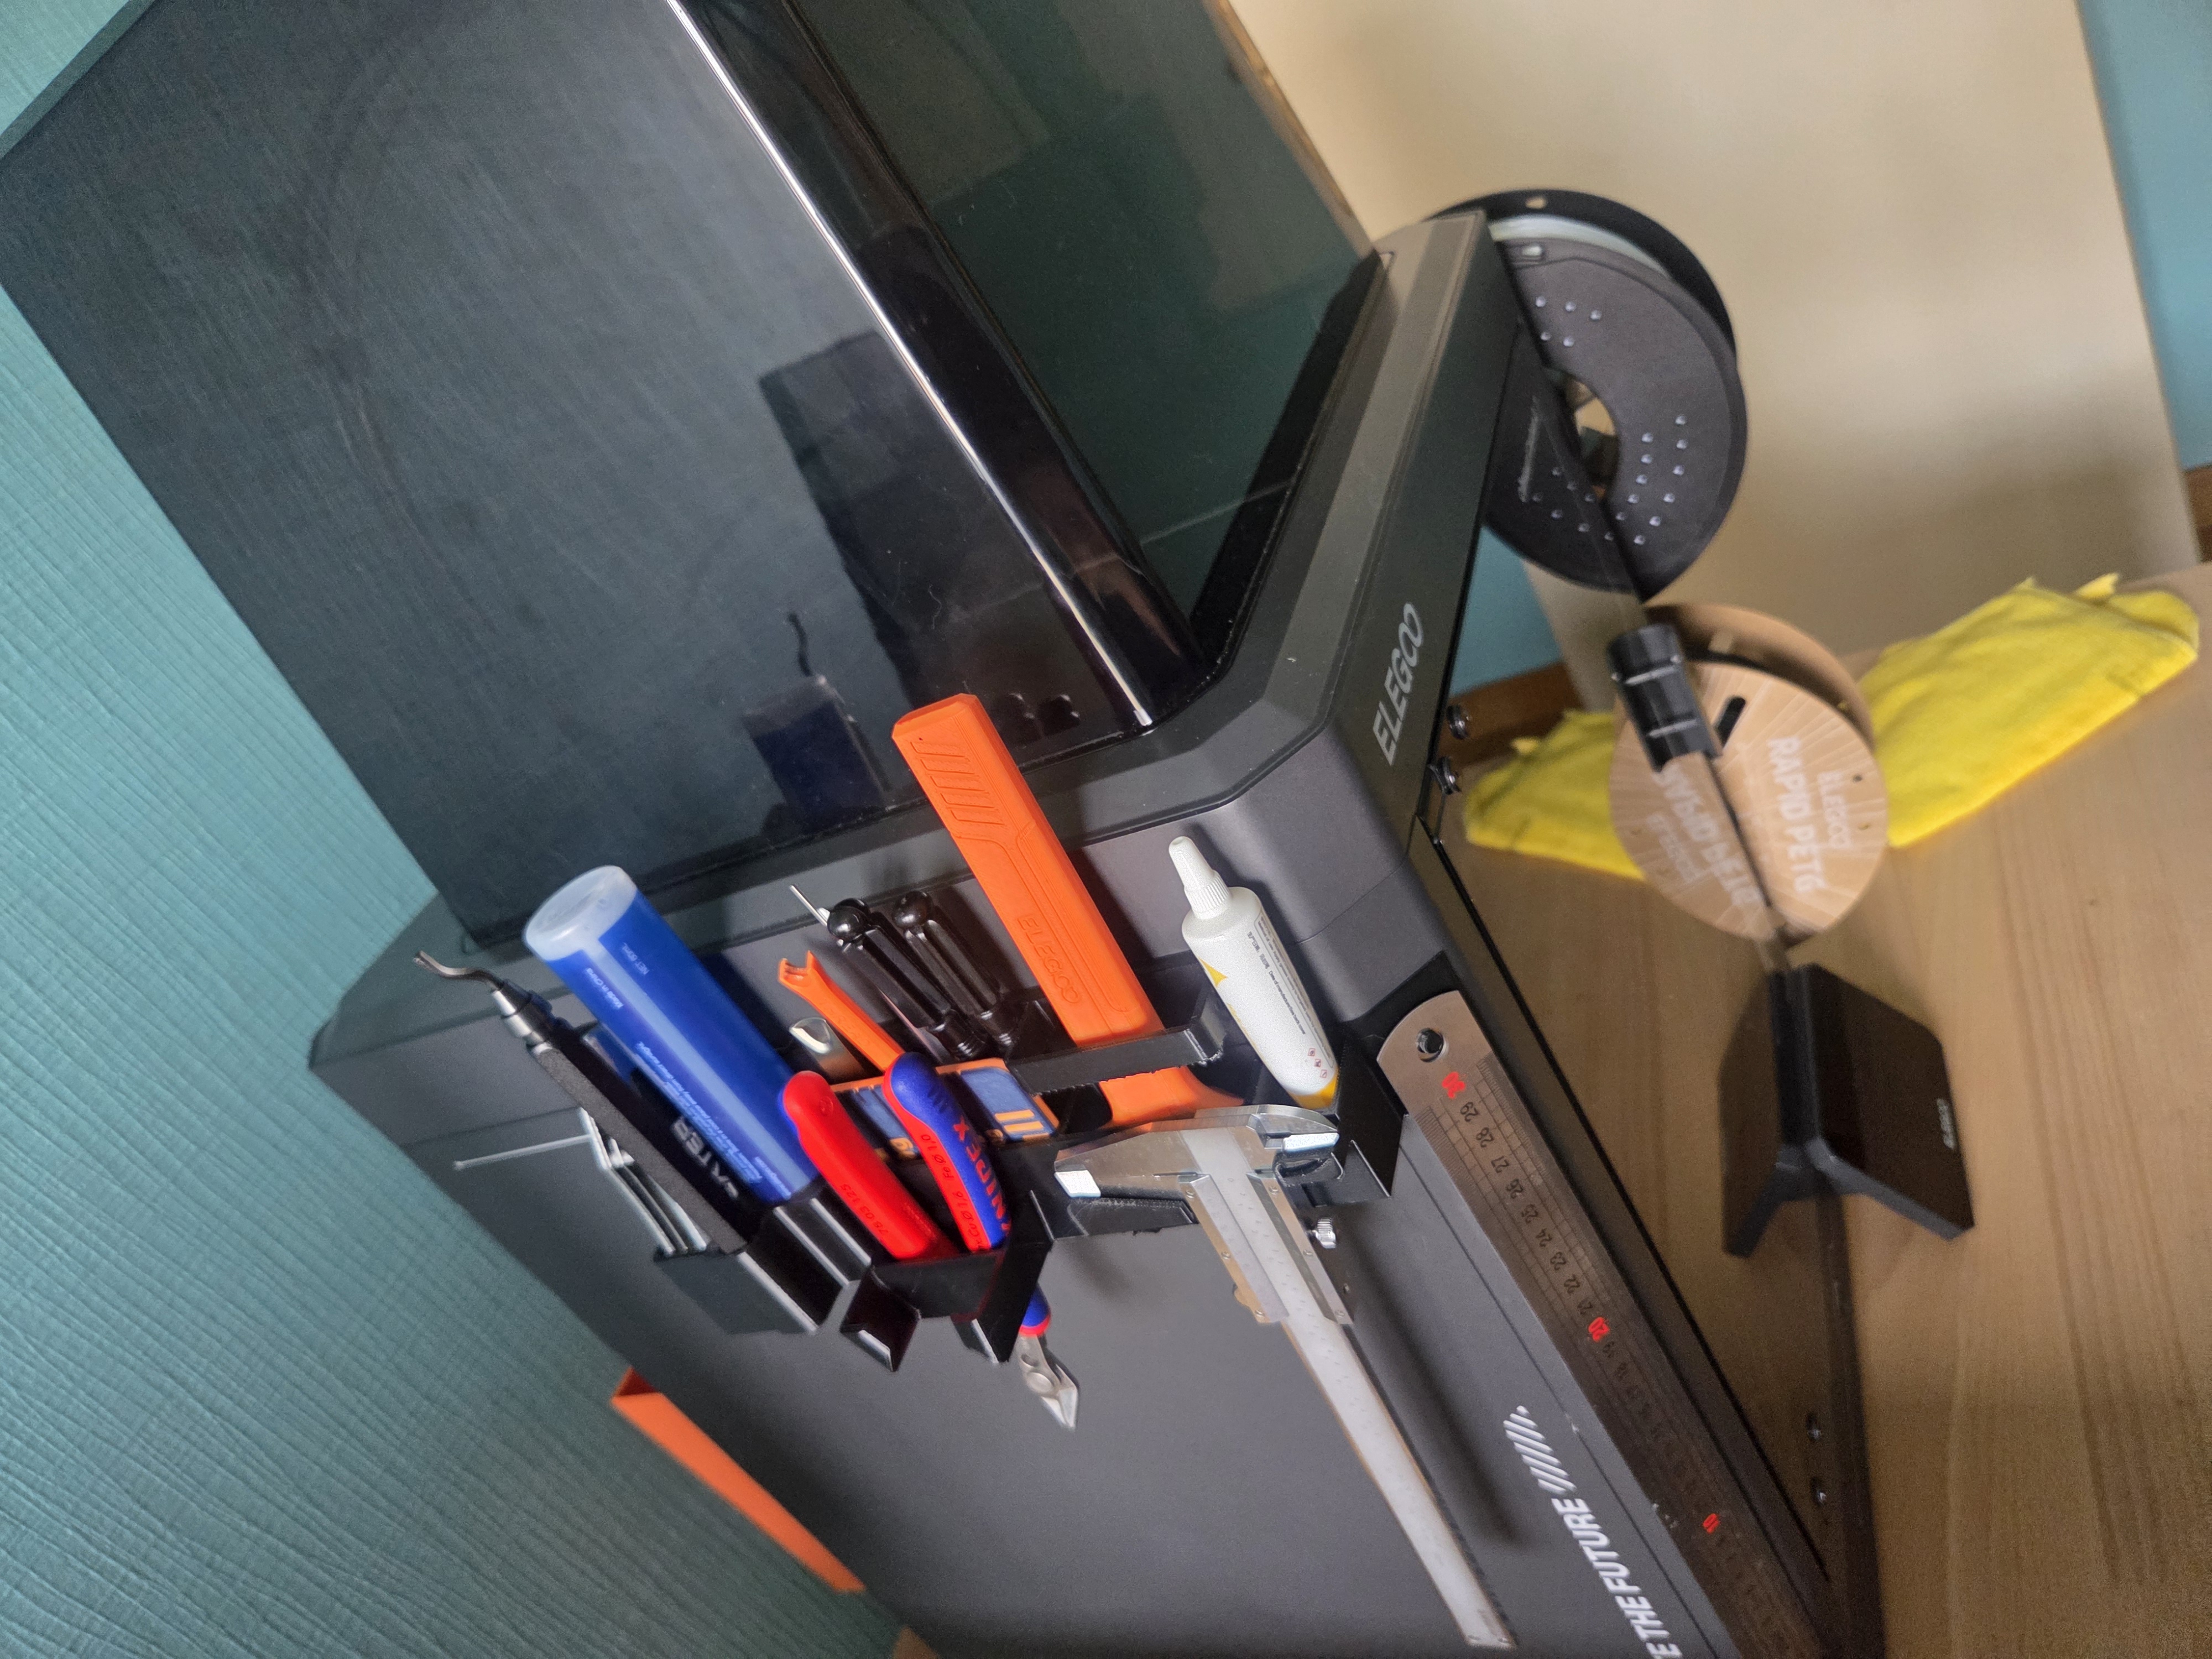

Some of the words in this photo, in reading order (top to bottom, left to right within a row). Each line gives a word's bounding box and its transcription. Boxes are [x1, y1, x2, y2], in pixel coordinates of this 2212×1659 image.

[1372, 602, 1424, 766] ELEGOO
[1767, 736, 1812, 821] RAPID
[1787, 825, 1826, 894] PETG
[586, 968, 604, 985] China
[1017, 915, 1081, 1005] ELEGOO
[921, 1133, 938, 1150] 1,0
[933, 1152, 946, 1166] Ø
[842, 1183, 861, 1204] 125
[942, 1166, 954, 1182] Fe
[1460, 1100, 1479, 1122] 29
[1475, 1128, 1494, 1147] 28
[1490, 1157, 1509, 1173] 27
[1505, 1180, 1524, 1199] 26
[1521, 1204, 1538, 1224] 25
[1535, 1229, 1553, 1247] 24
[1550, 1251, 1567, 1270] 23
[1564, 1275, 1580, 1294] 22
[1588, 1317, 1609, 1341] 20
[1551, 1498, 1642, 1595] FUTURE
[1615, 1595, 1670, 1642] THE
